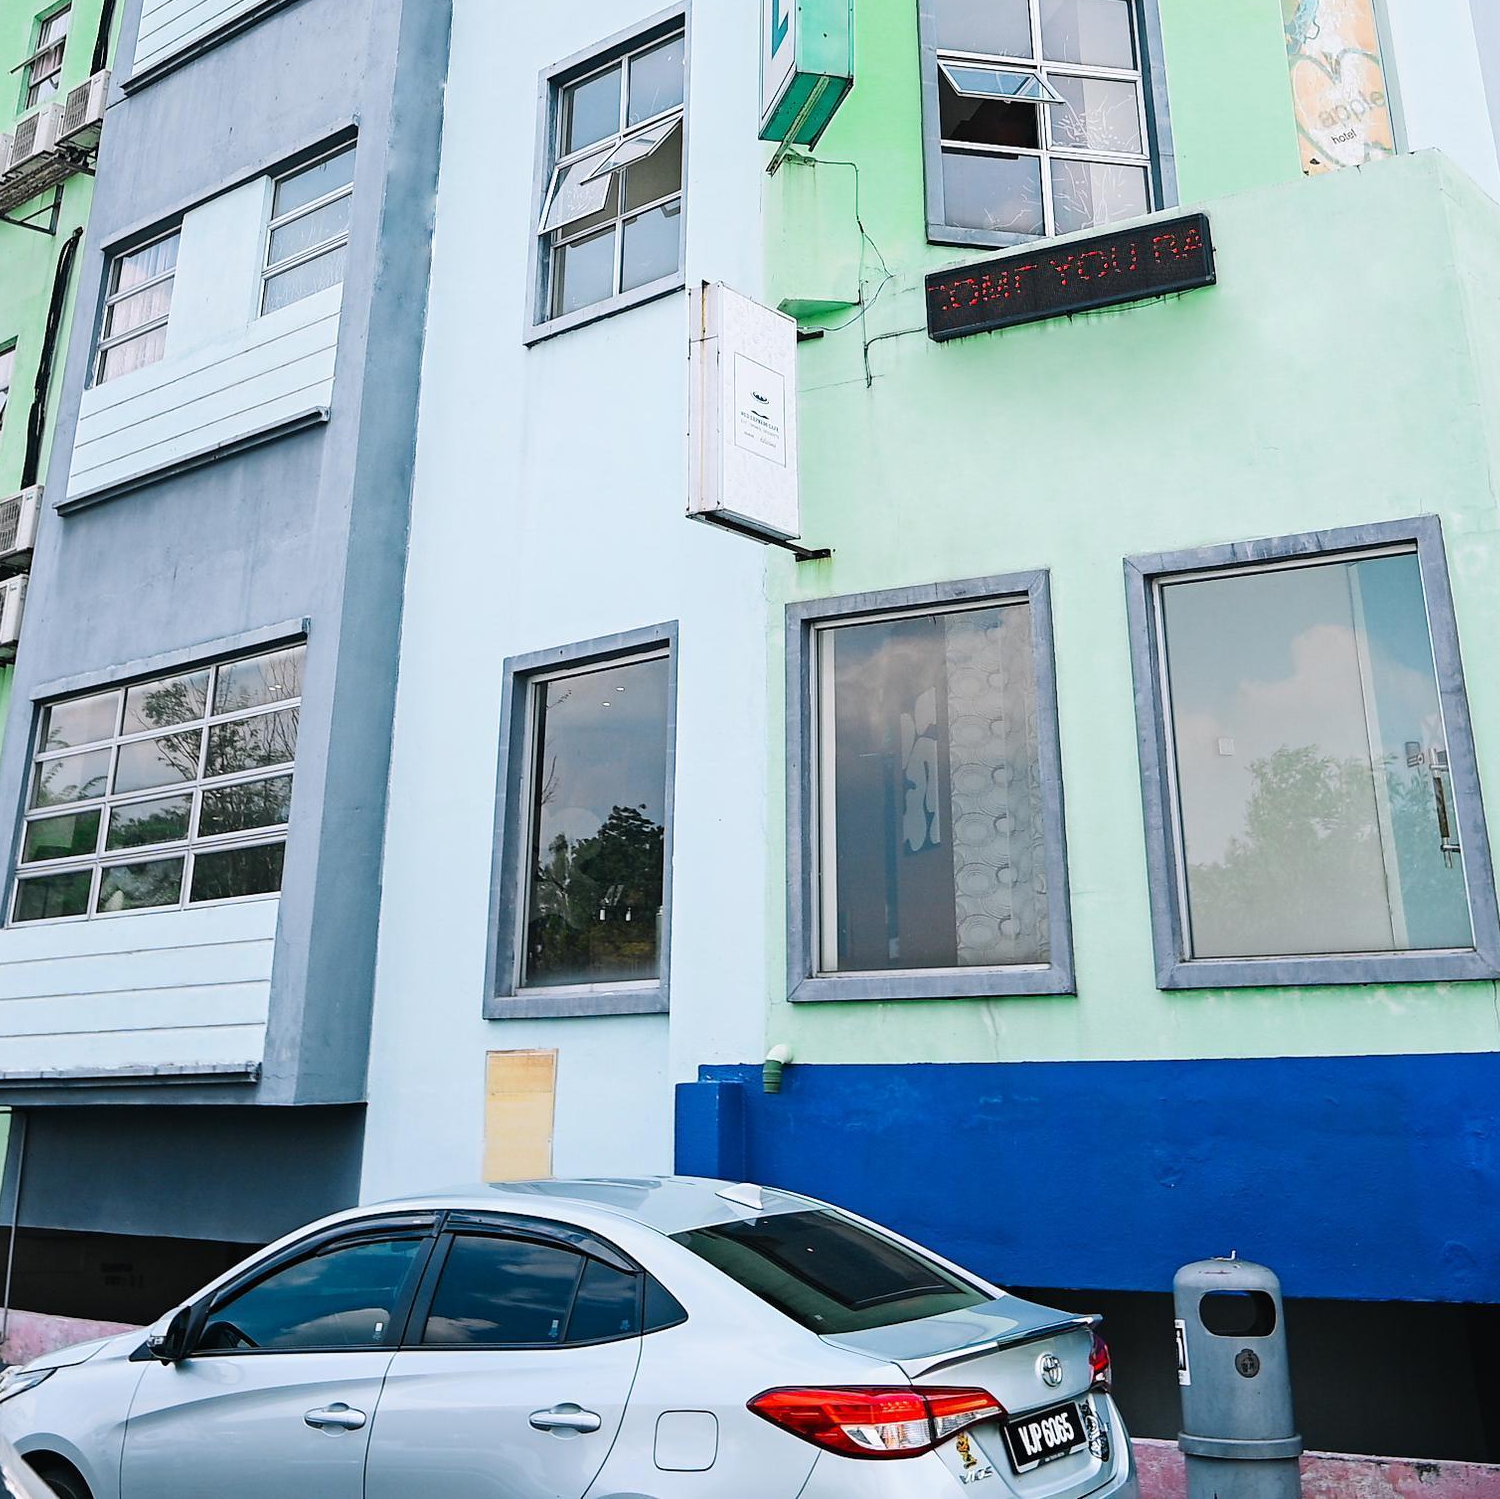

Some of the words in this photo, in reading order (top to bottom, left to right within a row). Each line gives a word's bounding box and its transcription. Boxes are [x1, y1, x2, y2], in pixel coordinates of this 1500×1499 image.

[1318, 88, 1386, 130] apple
[1331, 128, 1358, 146] hotel
[1041, 1411, 1075, 1449] 6065
